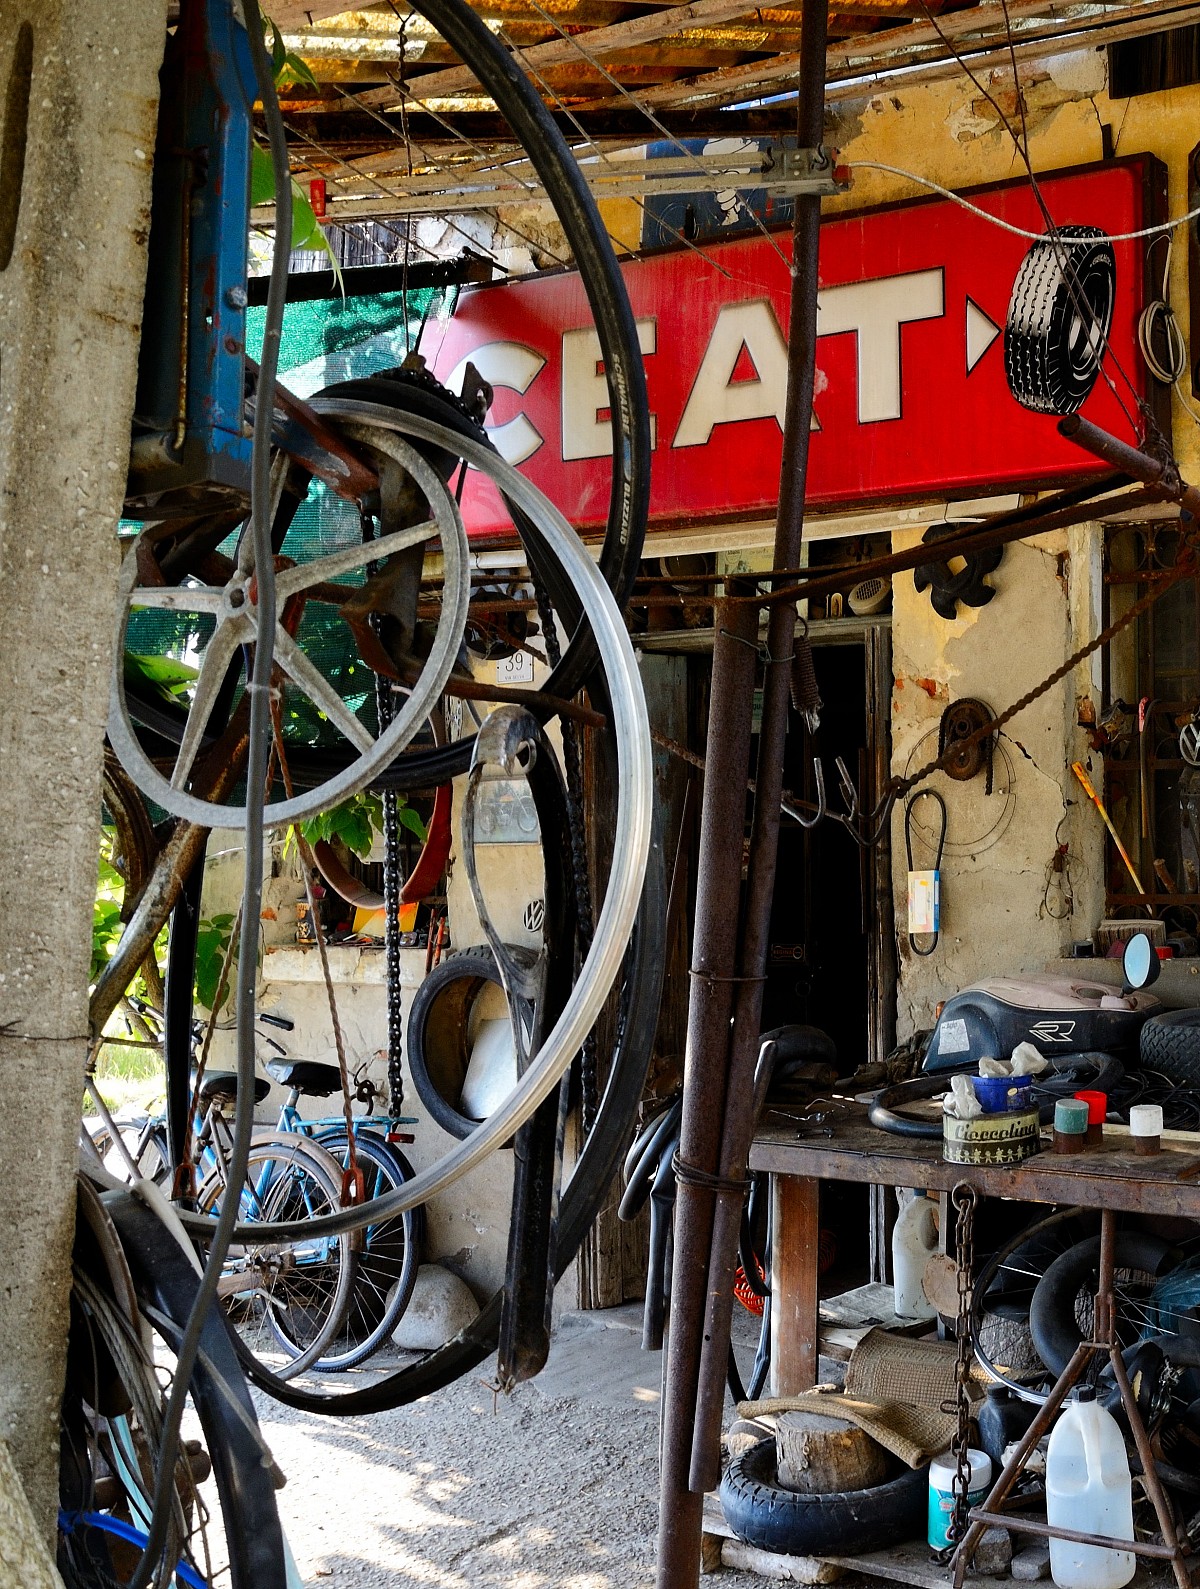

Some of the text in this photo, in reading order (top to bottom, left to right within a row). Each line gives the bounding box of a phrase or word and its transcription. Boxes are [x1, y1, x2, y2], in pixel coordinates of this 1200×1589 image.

[448, 266, 946, 472] CEAT
[612, 353, 631, 546] SCHWALBE BLIZZARD
[505, 652, 523, 671] 39
